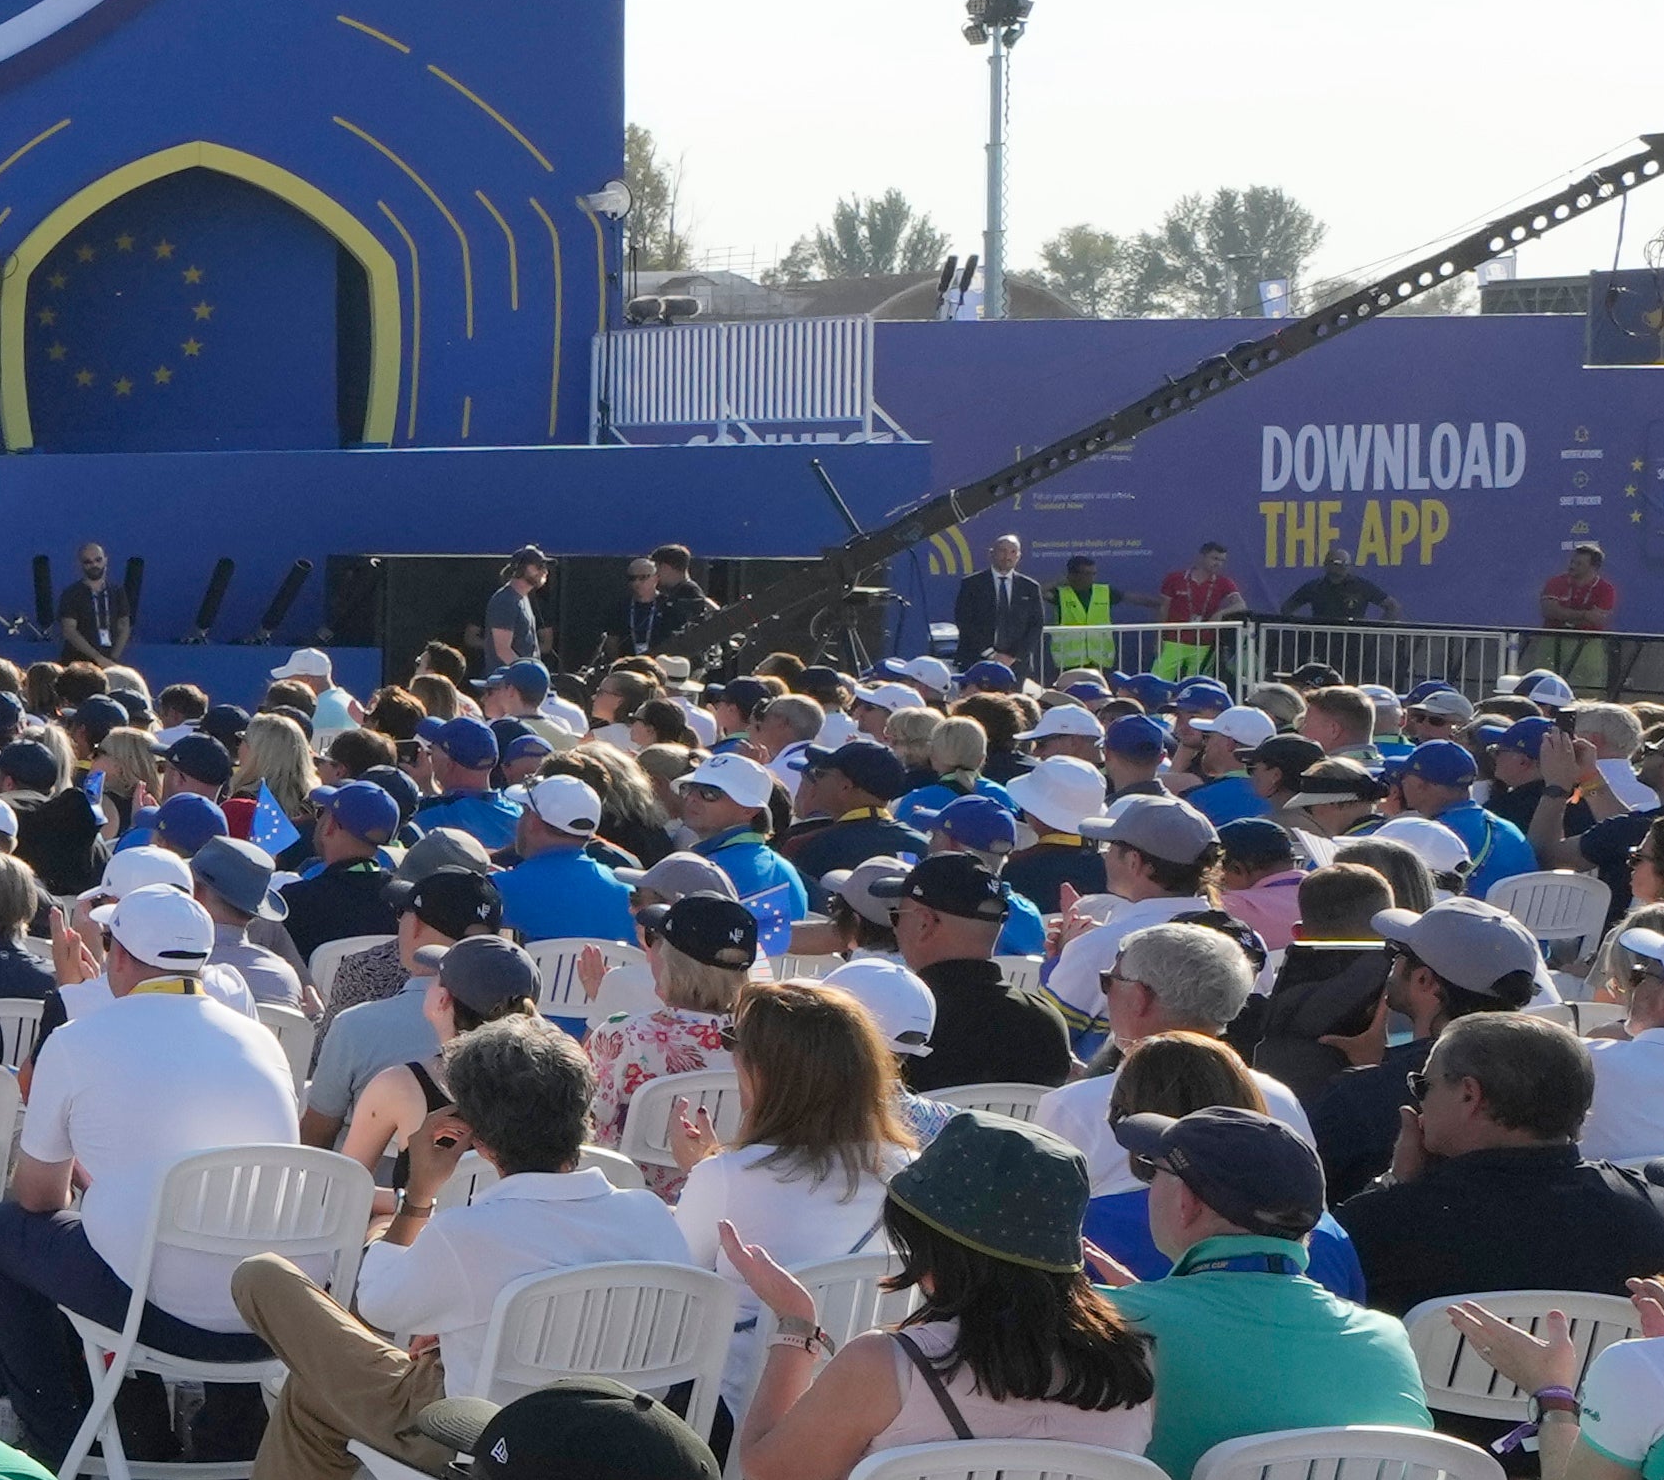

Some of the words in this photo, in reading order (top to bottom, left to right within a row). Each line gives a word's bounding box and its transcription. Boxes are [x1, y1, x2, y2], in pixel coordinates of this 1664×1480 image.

[1260, 421, 1527, 493] DOWNLOAD
[1259, 500, 1342, 568] THE
[1355, 499, 1449, 567] APP
